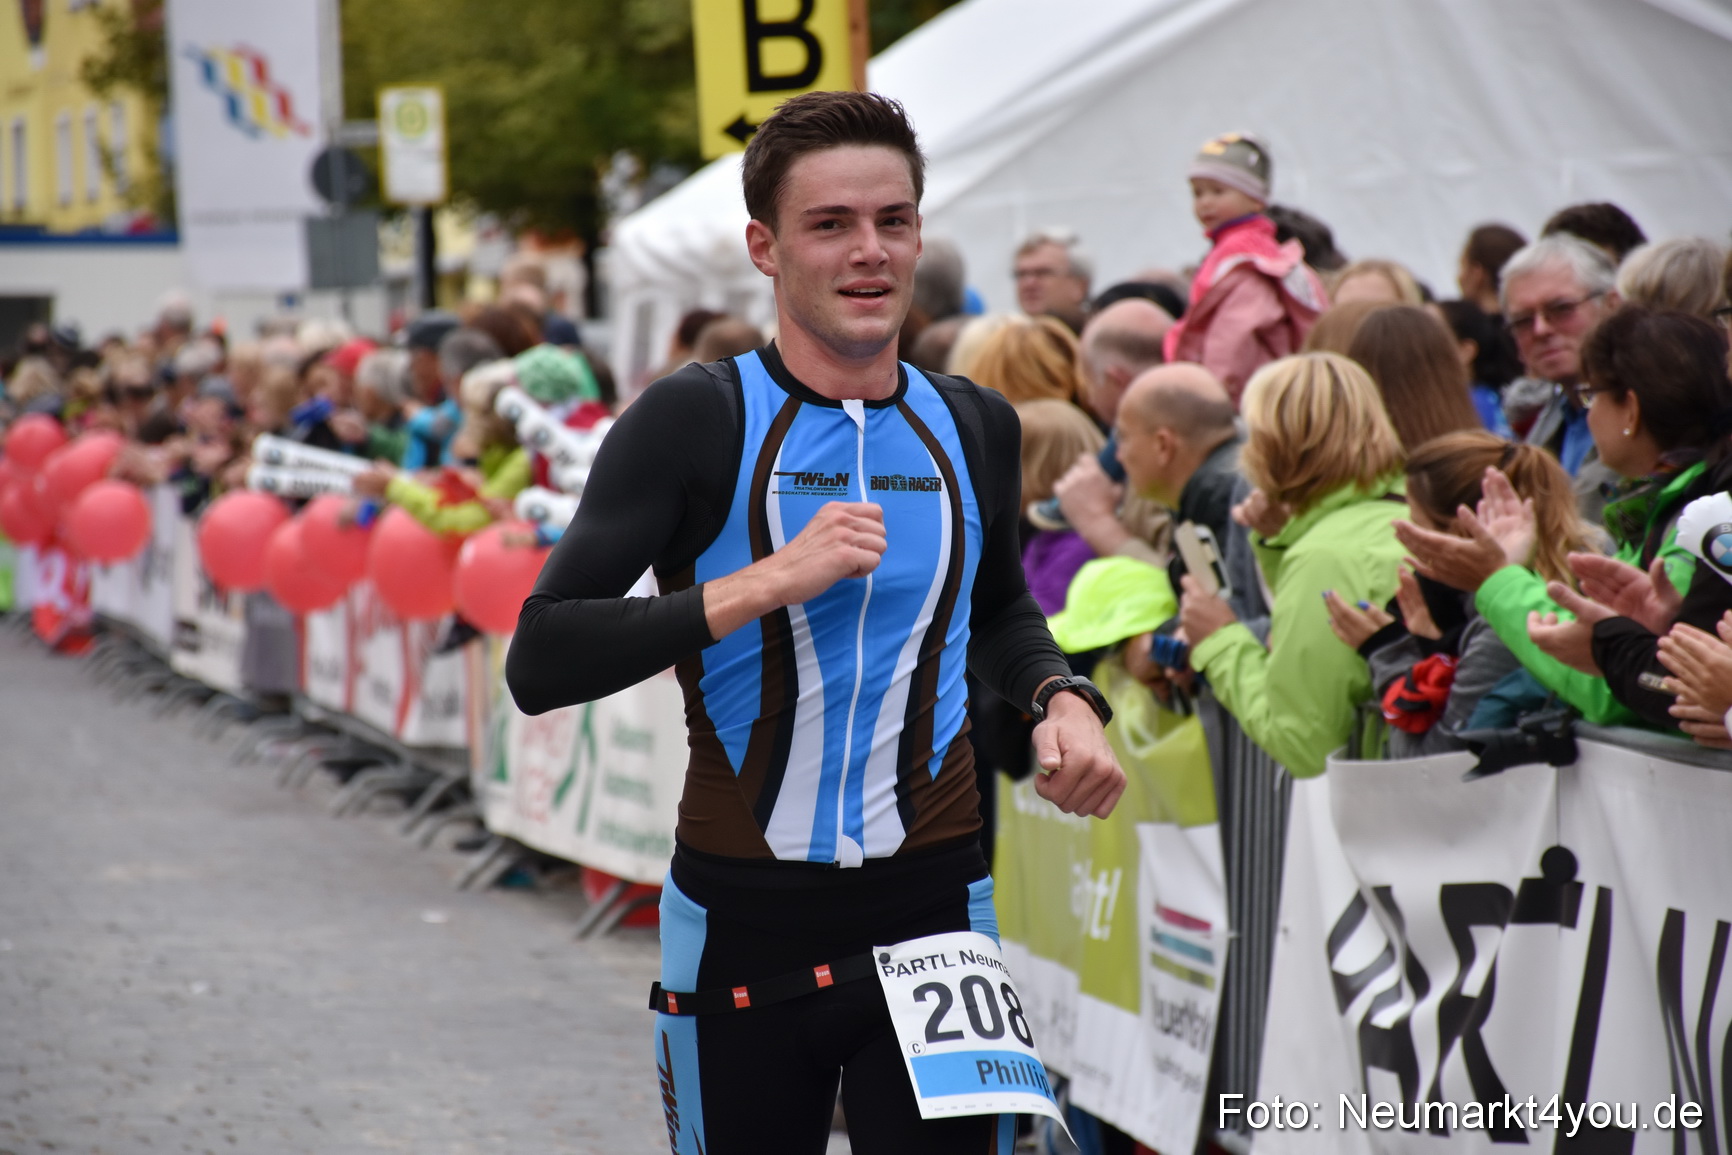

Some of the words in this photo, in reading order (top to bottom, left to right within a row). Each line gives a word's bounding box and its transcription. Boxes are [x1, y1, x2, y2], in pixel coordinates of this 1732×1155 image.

[743, 0, 823, 92] B
[908, 476, 942, 492] RACER
[881, 953, 956, 978] PARTL
[912, 974, 1035, 1049] 208
[911, 1042, 921, 1054] C
[975, 1059, 1051, 1098] Phillip
